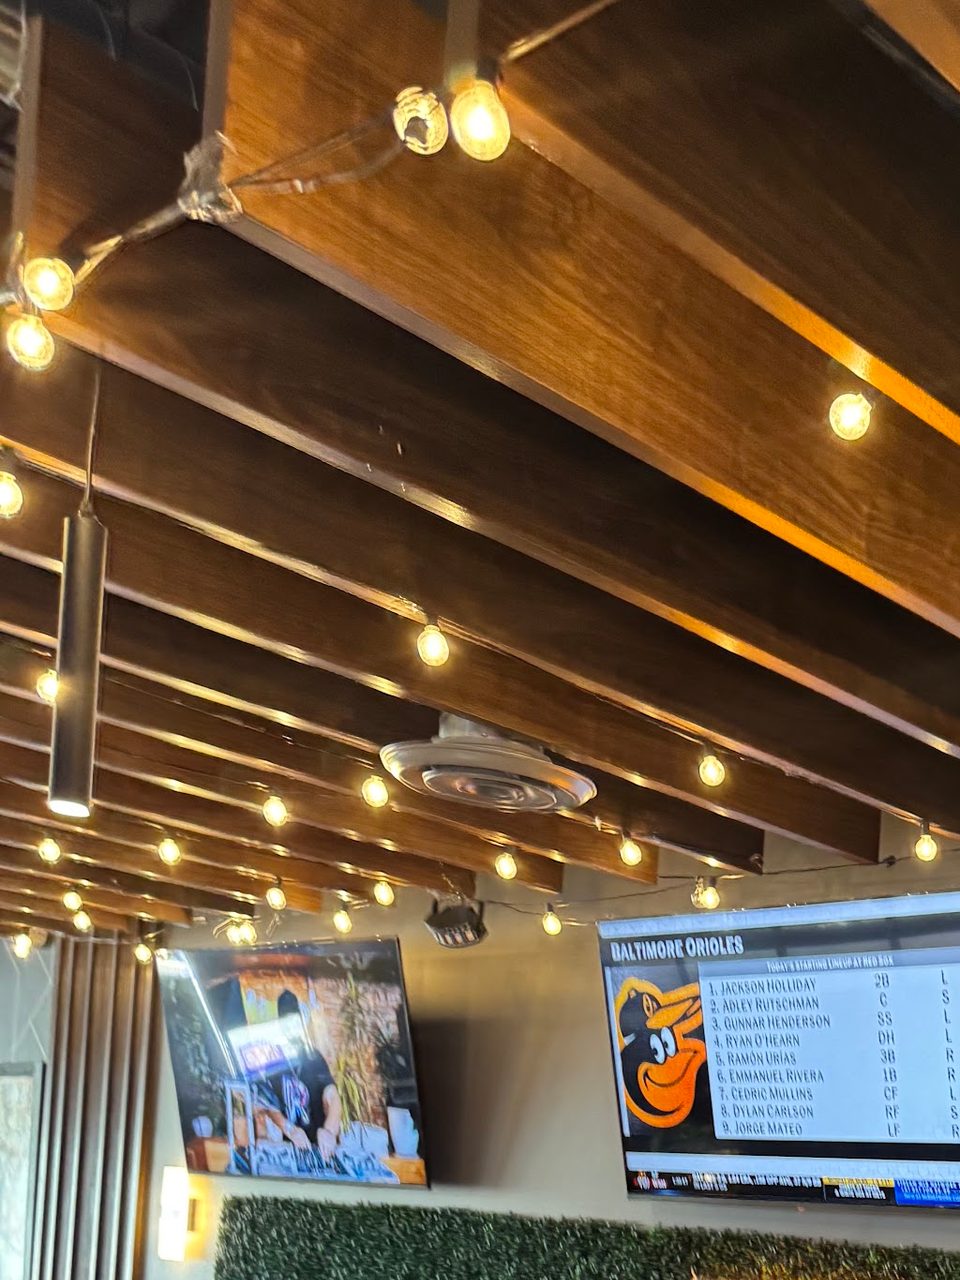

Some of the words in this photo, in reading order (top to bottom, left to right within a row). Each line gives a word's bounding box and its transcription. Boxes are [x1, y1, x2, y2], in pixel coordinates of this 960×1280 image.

[610, 938, 684, 962] BALTIMORE
[685, 935, 744, 957] ORIOLES
[721, 980, 764, 996] JACKSON
[767, 977, 816, 993] HOLLIDAY
[874, 973, 890, 988] 2B
[941, 969, 948, 985] L
[723, 998, 753, 1012] ADLEY
[755, 996, 820, 1011] RUTSCHMAN
[880, 992, 888, 1008] C
[942, 989, 950, 1005] S
[724, 1015, 765, 1030] GUNNAR
[767, 1014, 831, 1028] HENDERSON
[877, 1012, 893, 1027] SS
[944, 1009, 952, 1024] L
[725, 1033, 752, 1048] RYAN
[755, 1032, 800, 1047] O'HEARN
[878, 1030, 895, 1046] DH
[945, 1028, 953, 1044] L
[880, 1048, 896, 1064] 3B
[946, 1047, 954, 1063] R
[729, 1069, 784, 1084] EMMANUEL
[786, 1068, 824, 1083] RIVERA
[883, 1067, 897, 1082] 1B
[947, 1066, 956, 1082] R
[731, 1086, 767, 1101] CEDRIC
[769, 1086, 814, 1100] MULLINS
[884, 1086, 898, 1101] CF
[949, 1085, 957, 1101] L
[733, 1103, 765, 1118] DYLAN
[767, 1103, 814, 1119] CARLSON
[885, 1104, 899, 1119] RF
[950, 1105, 958, 1119] S
[735, 1121, 765, 1136] JORGE
[767, 1121, 803, 1136] MATEO
[888, 1122, 900, 1137] LF
[952, 1124, 960, 1139] R
